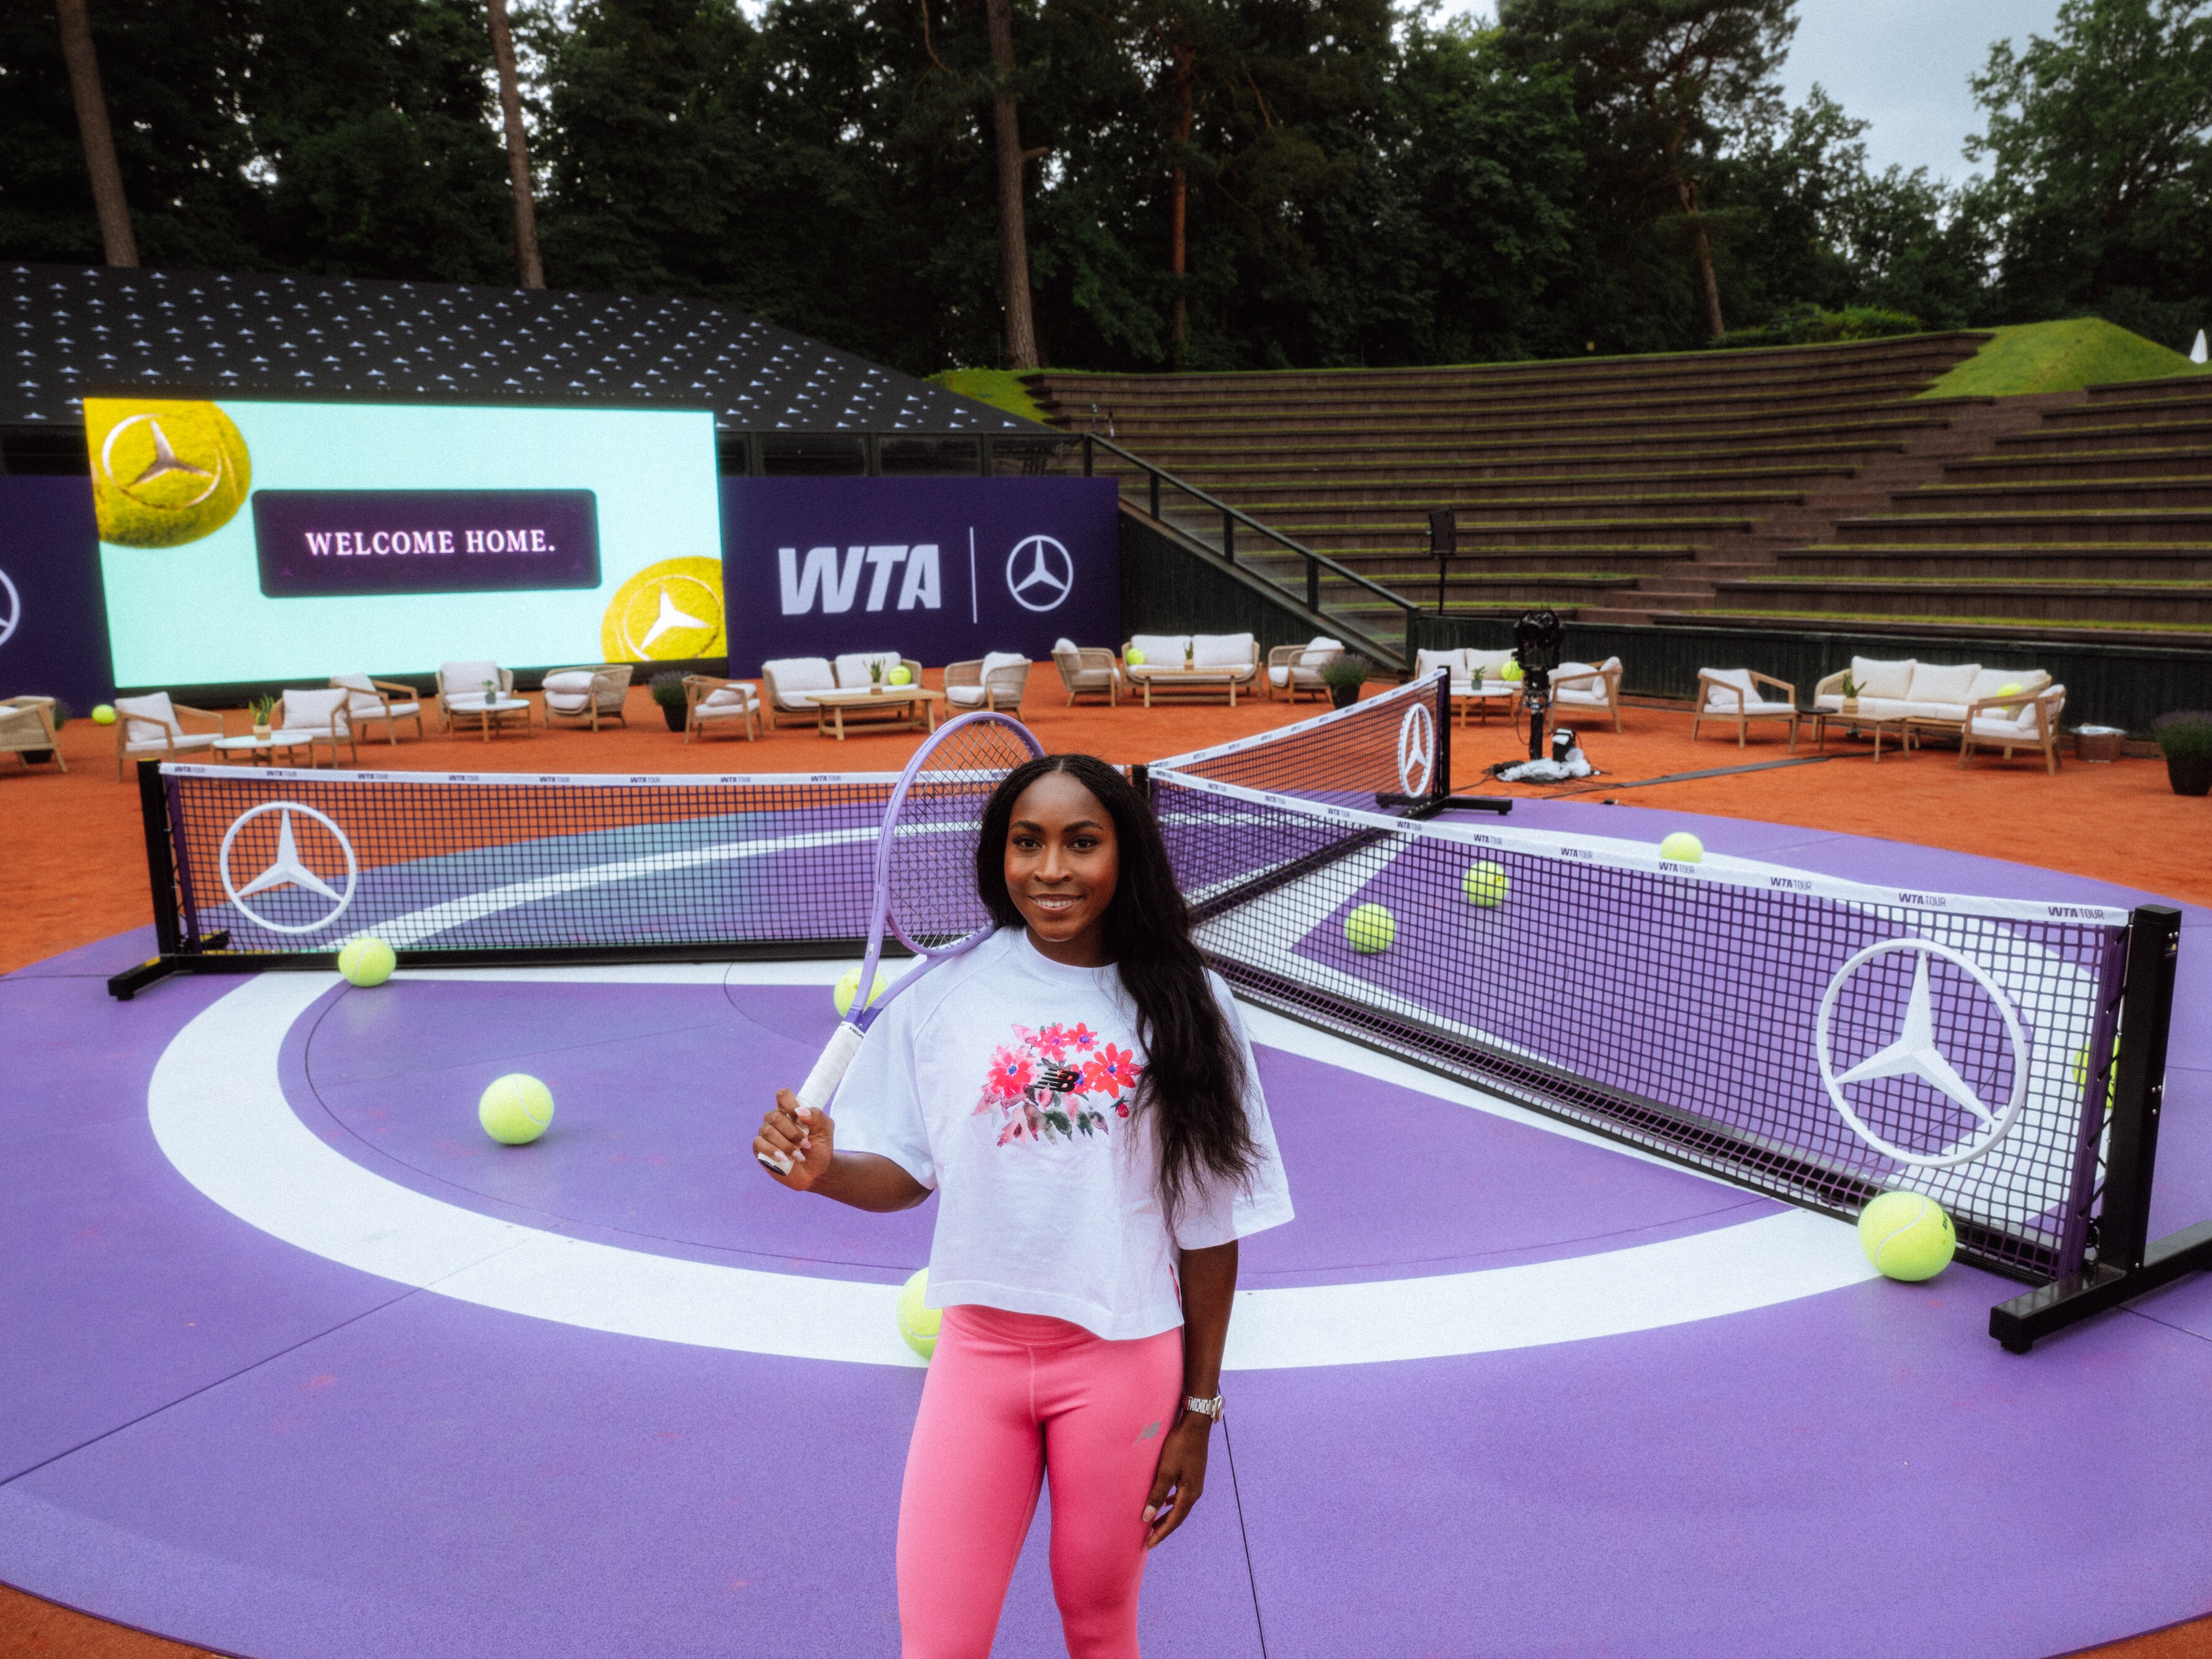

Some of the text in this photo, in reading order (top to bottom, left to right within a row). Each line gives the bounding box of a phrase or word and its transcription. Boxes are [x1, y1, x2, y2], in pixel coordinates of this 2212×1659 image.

[305, 529, 556, 556] WELCOME HOME.
[778, 544, 941, 615] WTA
[1327, 807, 1340, 816] WTA
[1396, 820, 1411, 829] WTA
[1474, 834, 1503, 845] WTA TOUR
[1561, 847, 1593, 860] WTA TOUR
[1659, 862, 1696, 875] WTA TOUR
[1771, 877, 1813, 891] WTA TOUR
[1898, 893, 1946, 907] WTA TOUR
[2048, 906, 2104, 919] WTA TOUR
